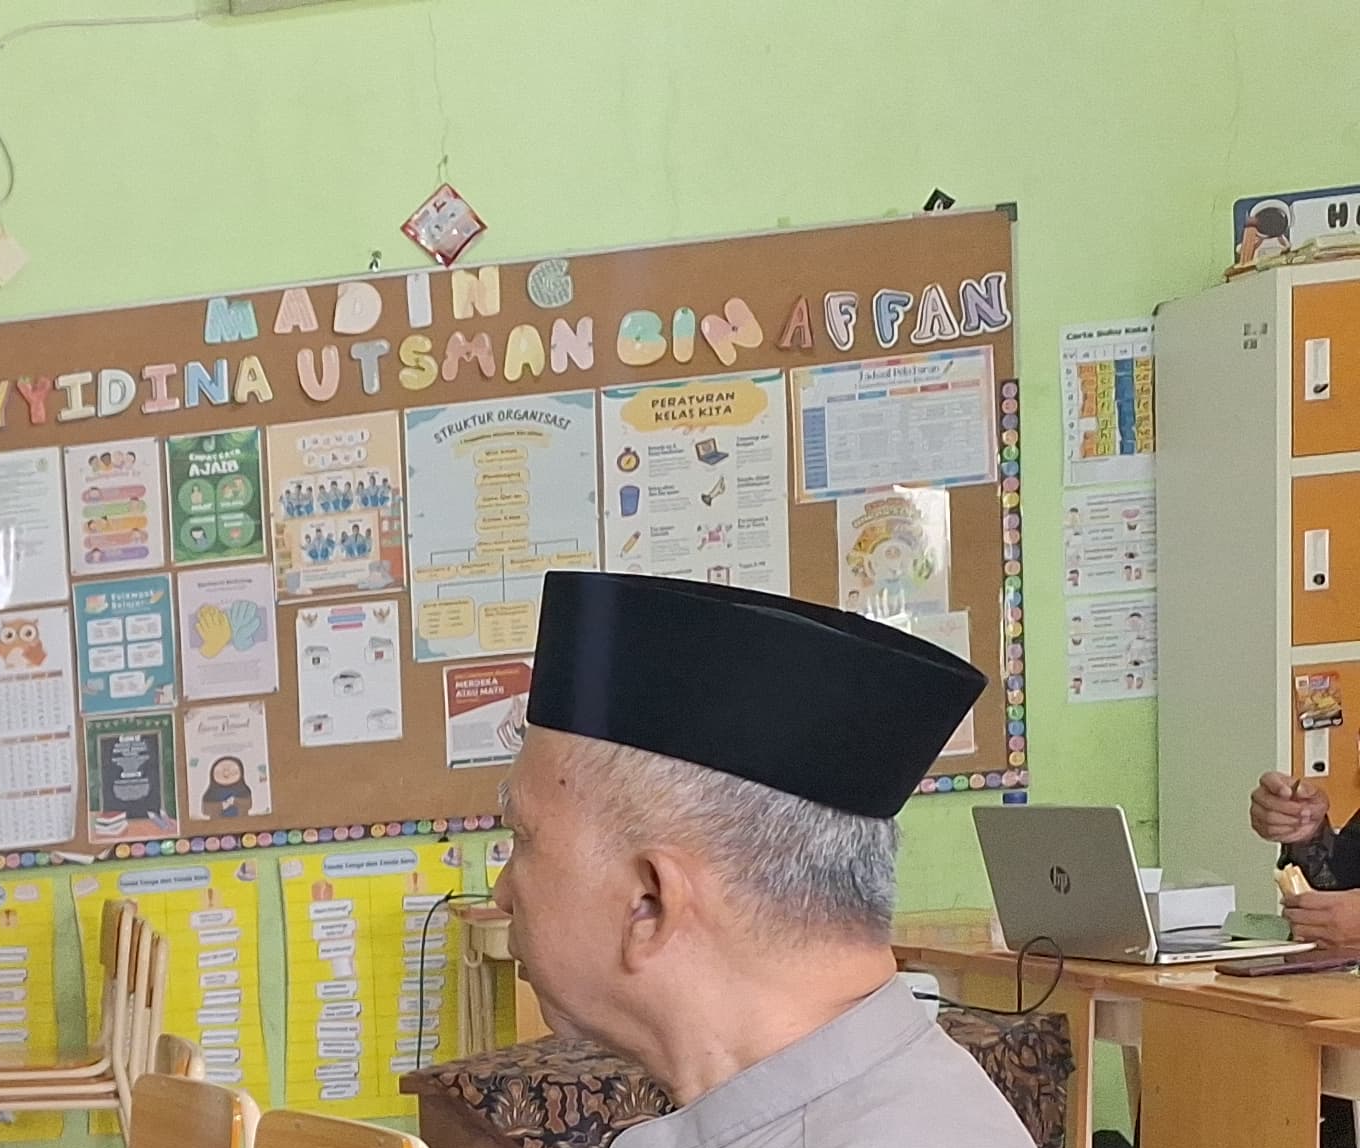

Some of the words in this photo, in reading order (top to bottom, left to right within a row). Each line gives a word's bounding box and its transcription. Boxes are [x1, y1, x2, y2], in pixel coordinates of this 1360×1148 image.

[1327, 202, 1360, 229] H
[203, 256, 574, 345] MADING
[296, 315, 595, 402] UTSMAN
[616, 297, 764, 367] BIN
[777, 271, 1012, 352] AFFAN
[650, 391, 736, 409] PERATURAN
[654, 408, 695, 423] KELAS
[697, 404, 733, 417] KITA
[433, 411, 495, 444] STRUKTUR
[497, 407, 572, 431] ORGANISASI
[188, 460, 240, 478] AJAIB
